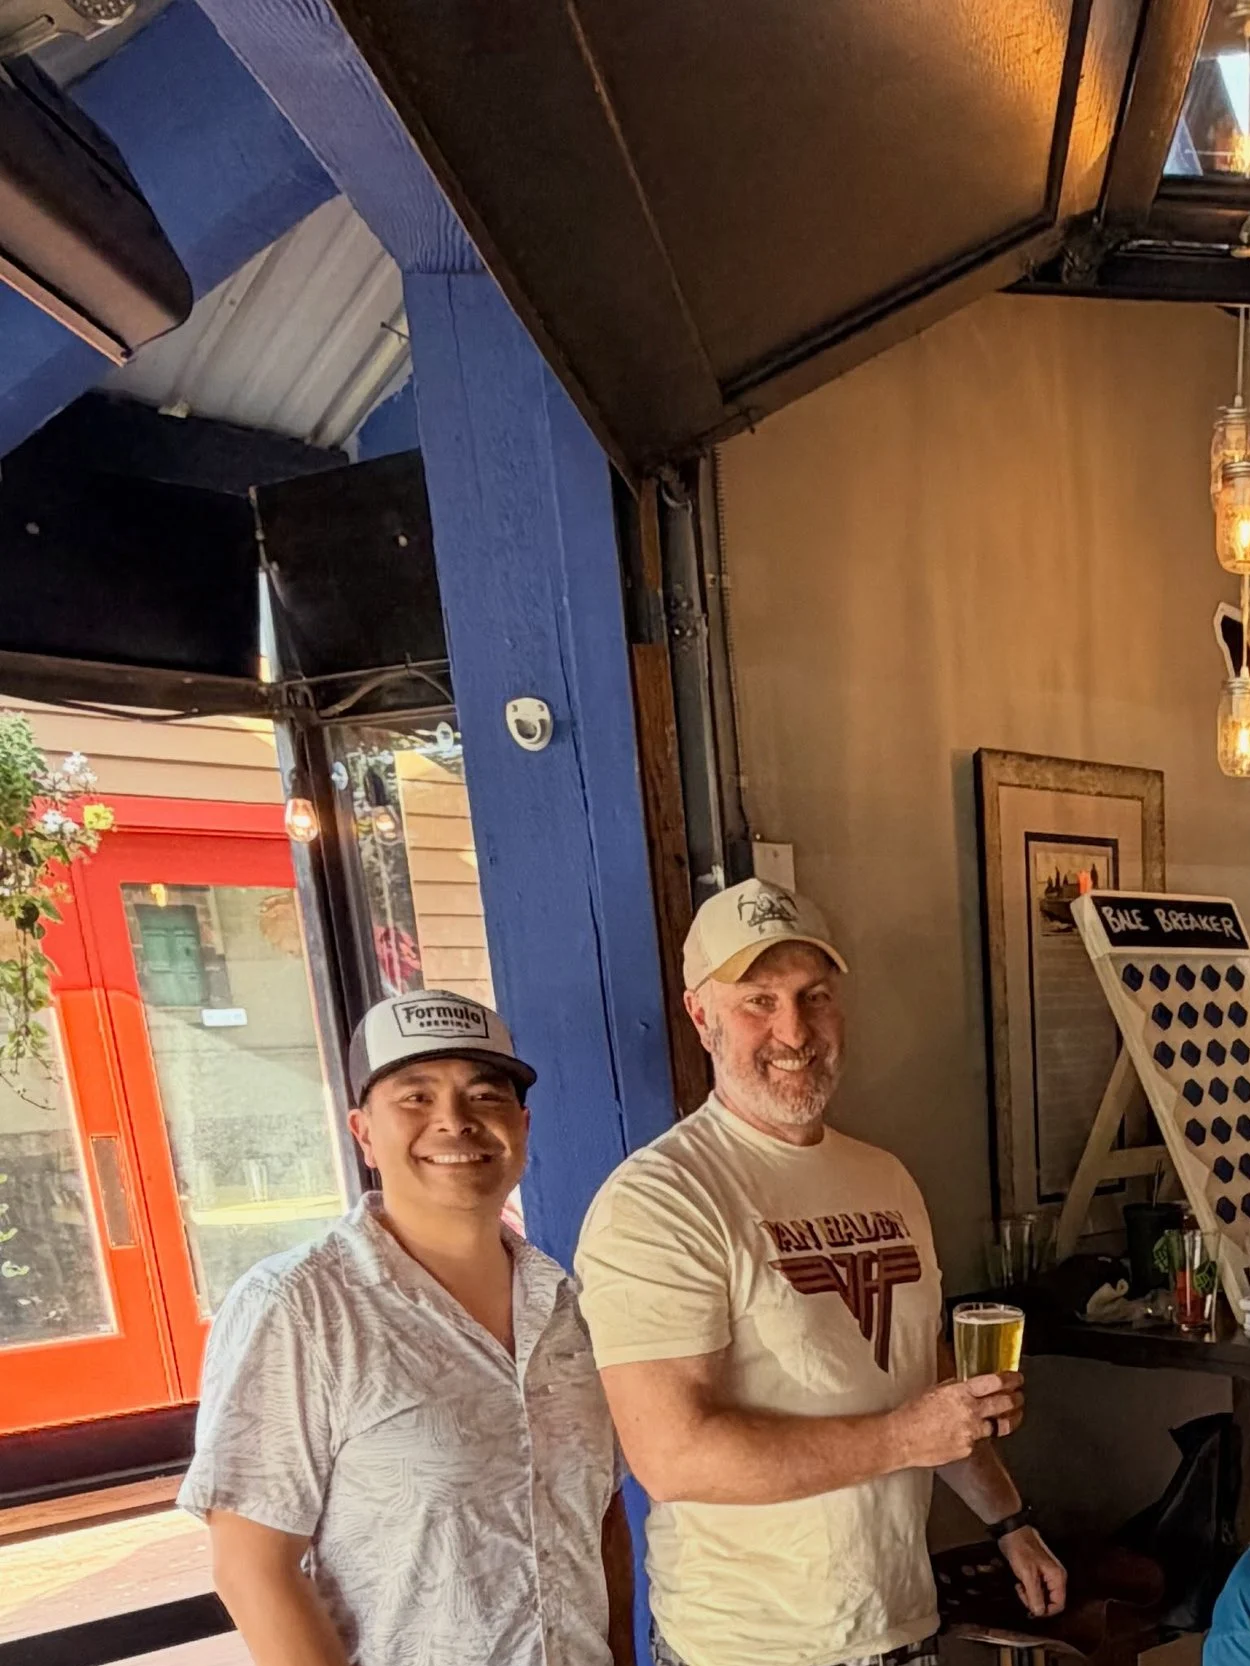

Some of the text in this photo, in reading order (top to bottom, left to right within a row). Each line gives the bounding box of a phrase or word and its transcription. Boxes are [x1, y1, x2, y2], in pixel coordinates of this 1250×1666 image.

[1101, 906, 1241, 940] BALE BREAKER
[402, 1004, 481, 1025] Formula
[814, 1210, 911, 1248] HALEN
